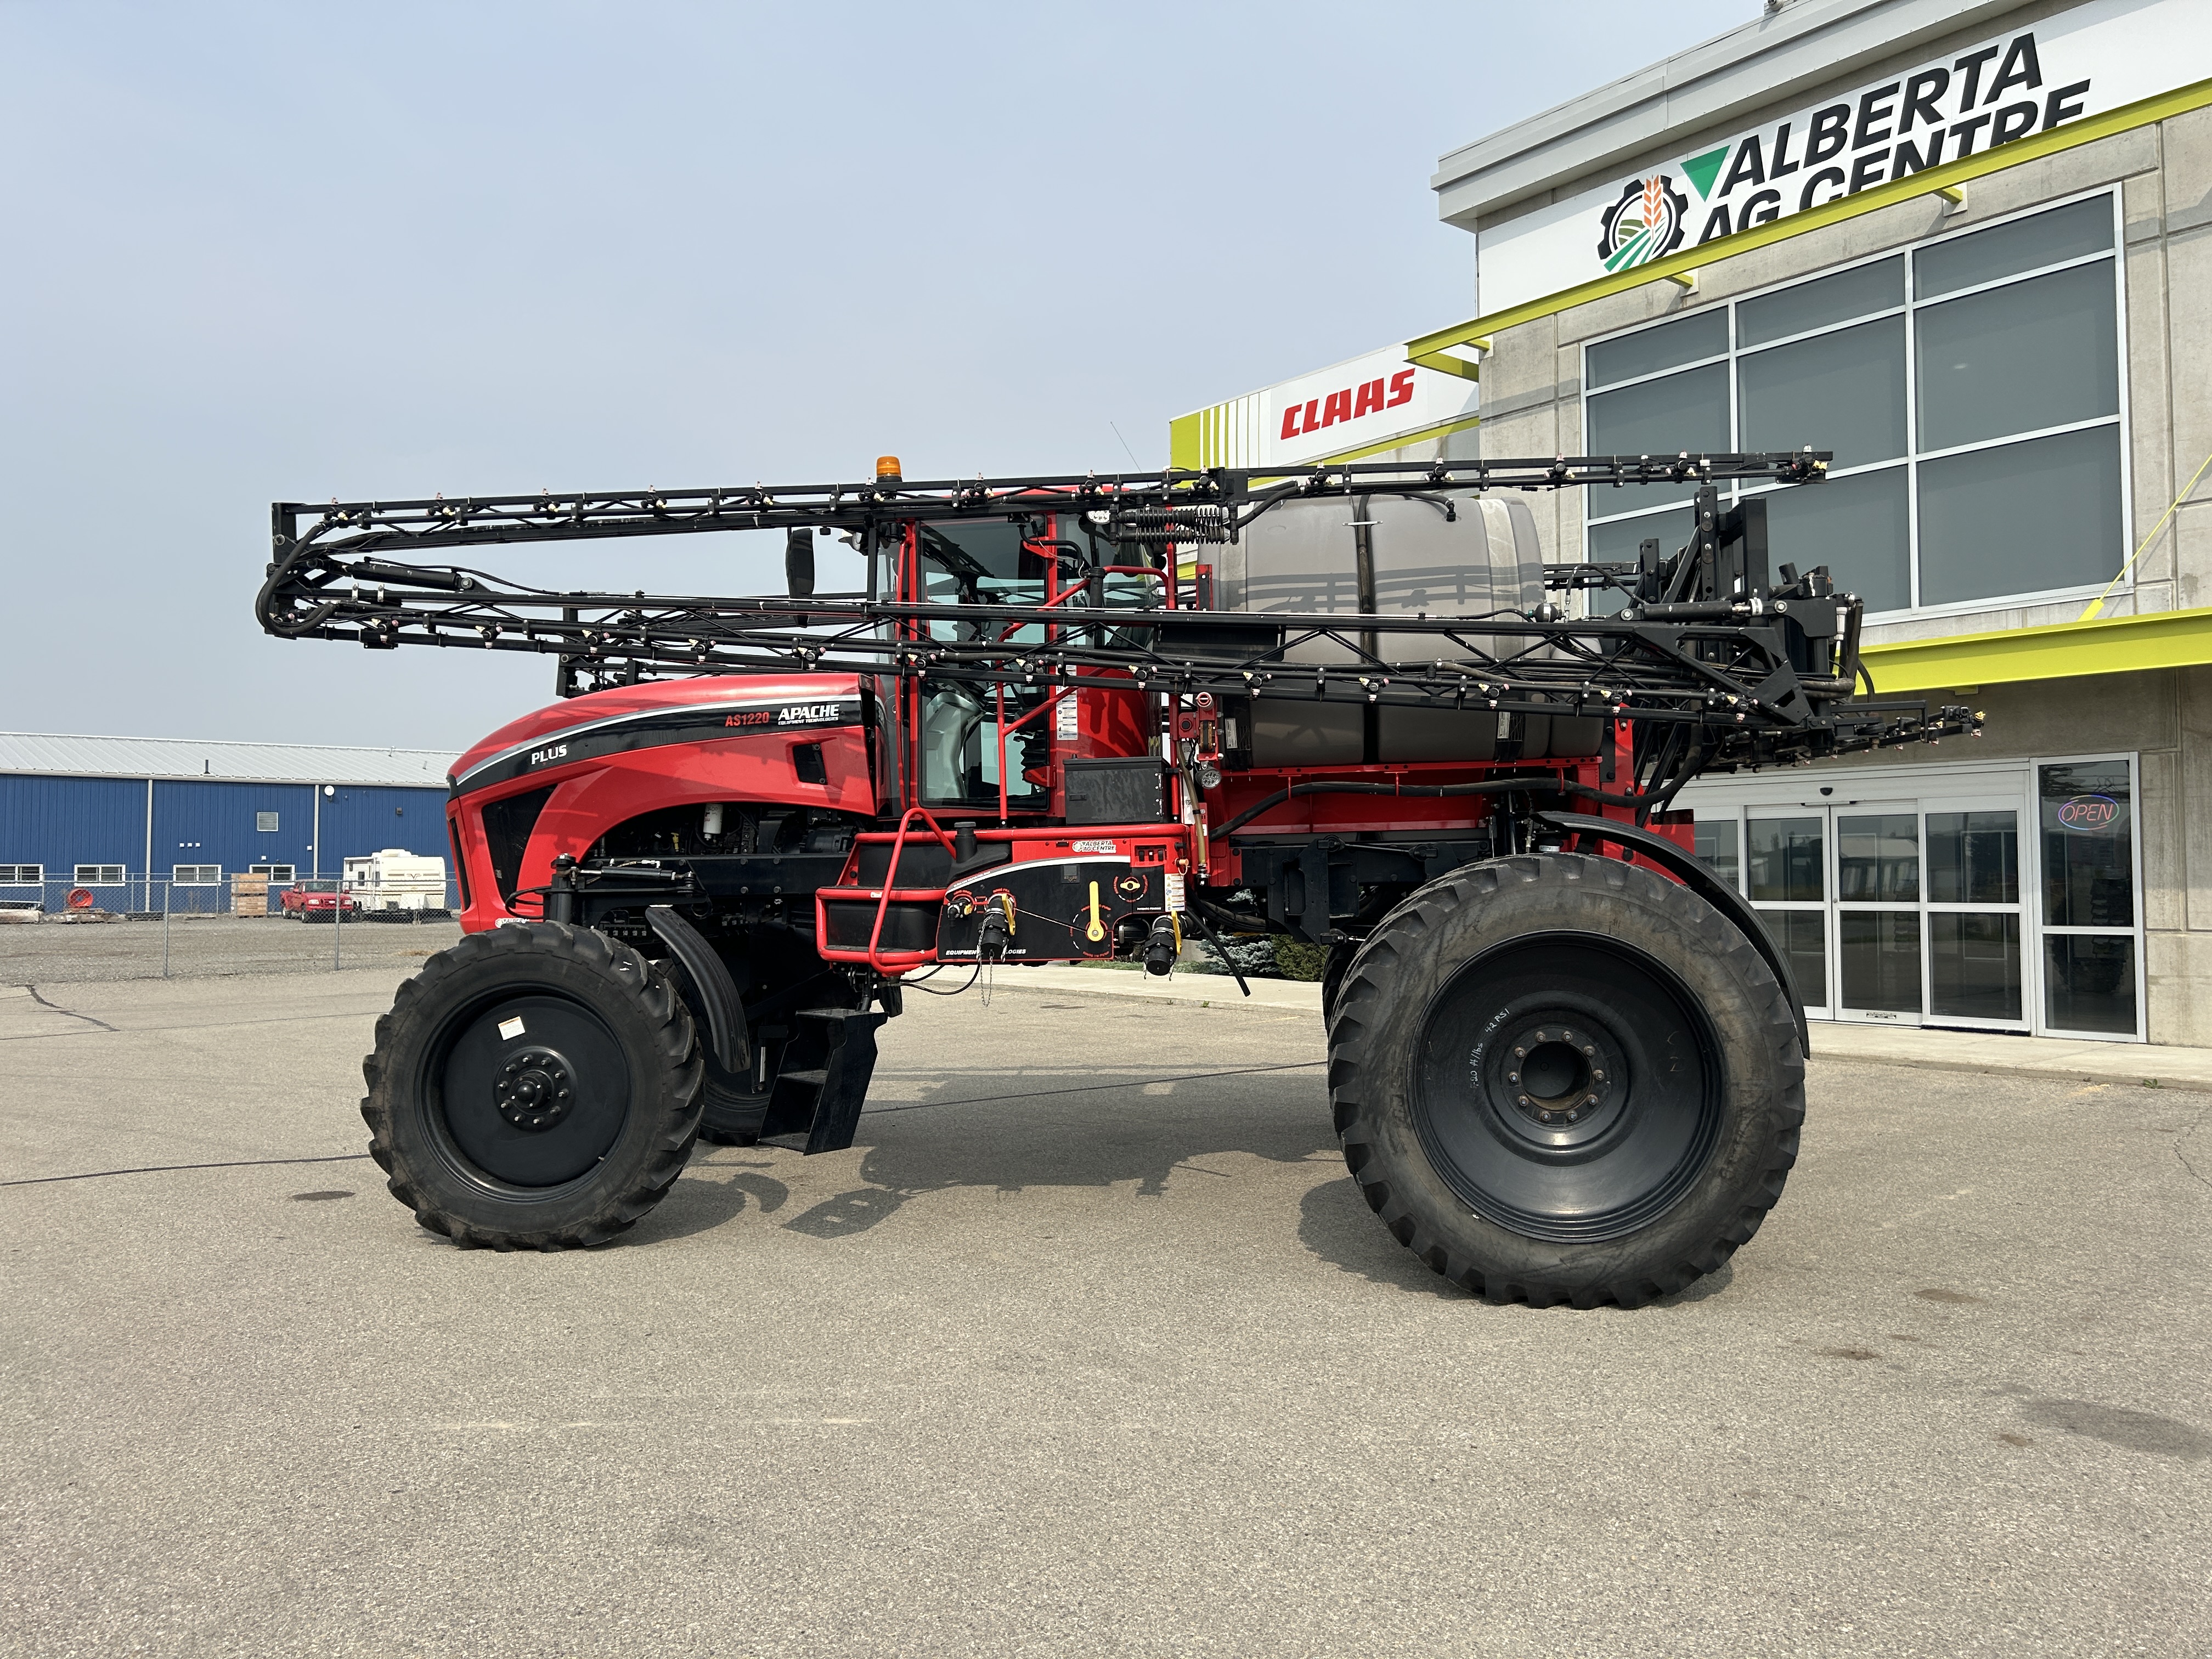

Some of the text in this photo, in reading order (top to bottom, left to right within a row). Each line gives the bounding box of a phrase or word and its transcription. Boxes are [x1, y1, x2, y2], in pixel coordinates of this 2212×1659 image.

[1717, 32, 2042, 198] ALBERTA
[1697, 78, 2091, 246] AG CENTRE
[1280, 368, 1415, 439] CLAAS
[725, 712, 770, 727] AS1220
[778, 704, 839, 720] APACHE
[532, 744, 567, 764] PLUS
[2062, 804, 2113, 821] OPEN
[1485, 1022, 1497, 1032] 42
[1494, 1008, 1510, 1022] PSI
